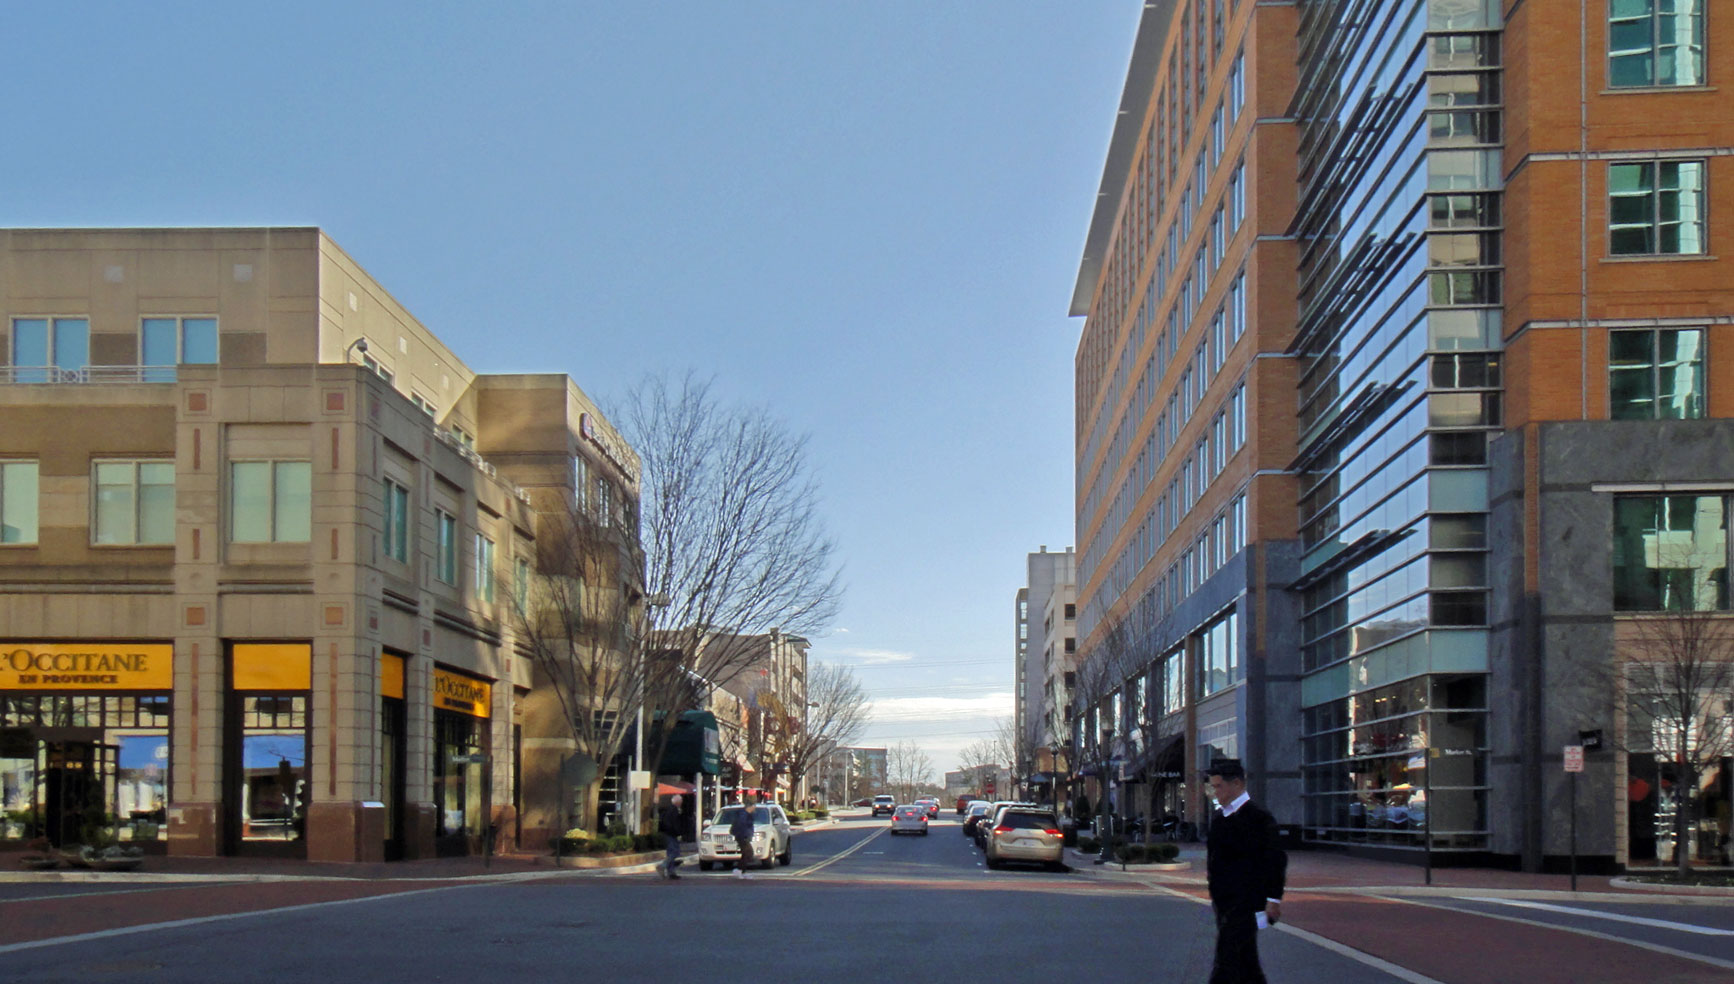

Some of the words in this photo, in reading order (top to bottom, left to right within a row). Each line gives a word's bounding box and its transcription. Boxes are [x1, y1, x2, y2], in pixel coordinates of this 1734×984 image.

[0, 648, 148, 672] 'OCCITANE
[18, 674, 38, 684] EN
[42, 674, 118, 684] PROVENCE
